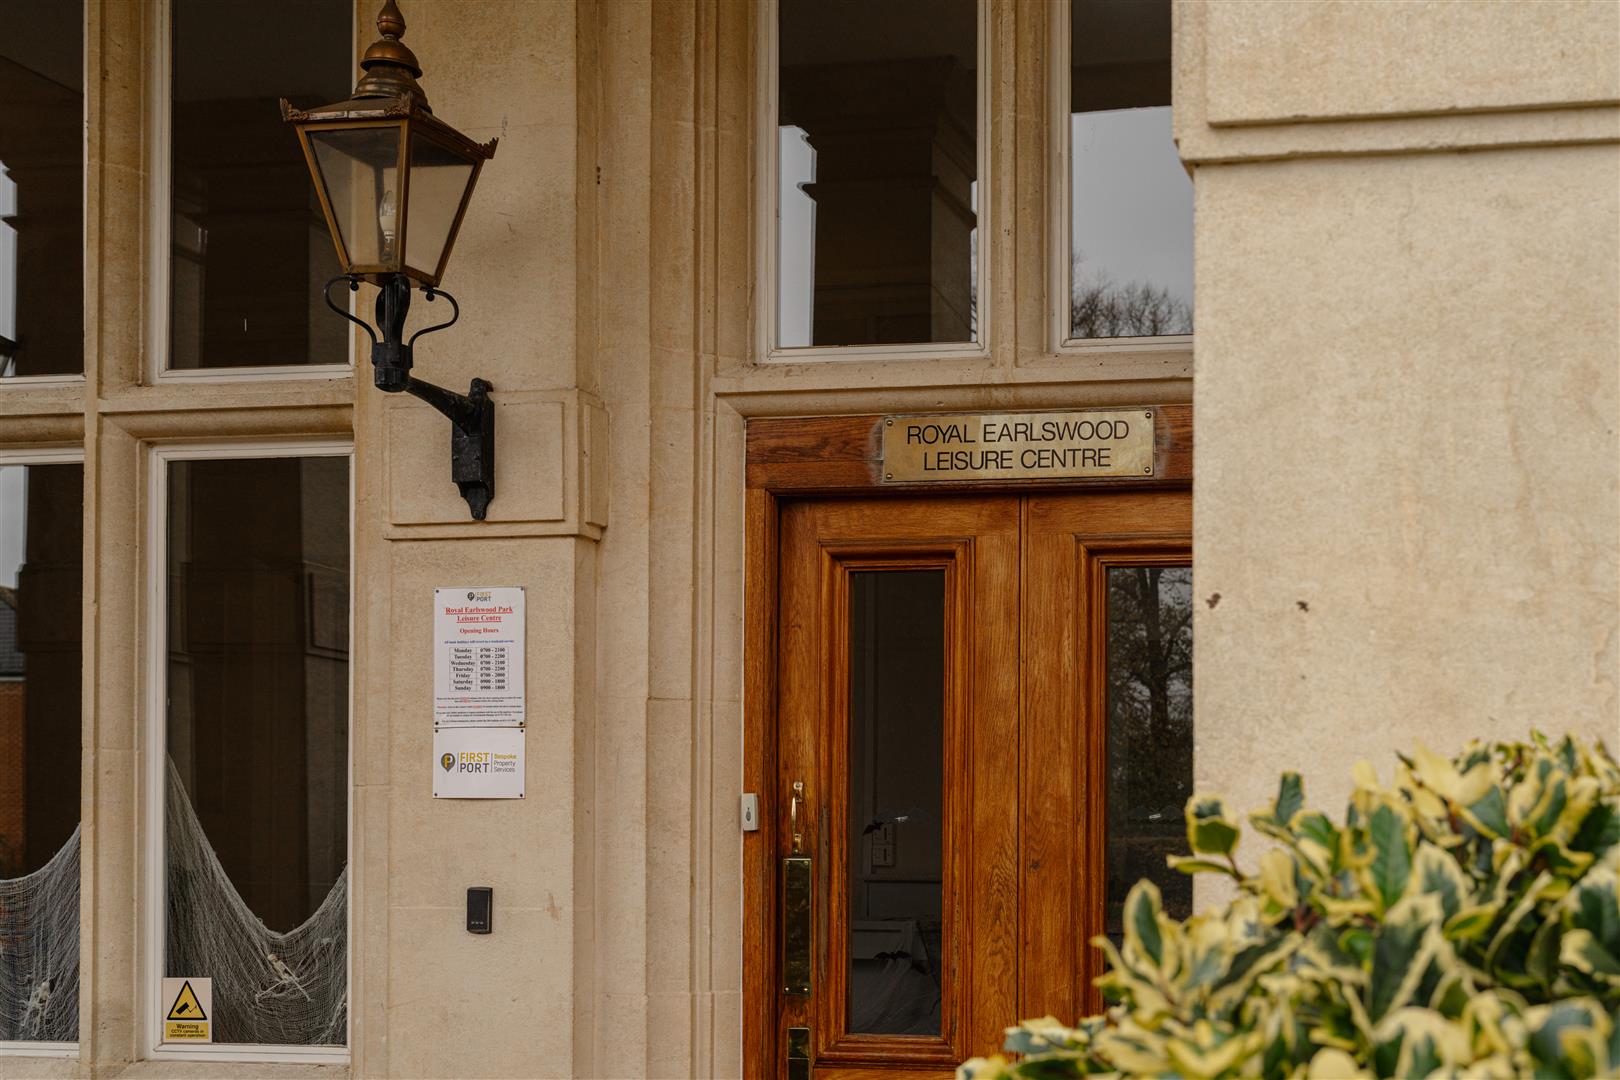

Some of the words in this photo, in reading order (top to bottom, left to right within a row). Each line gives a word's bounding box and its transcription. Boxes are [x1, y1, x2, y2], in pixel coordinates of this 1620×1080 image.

[907, 424, 976, 445] ROYAL
[983, 420, 1130, 443] EARLSWOOD
[923, 450, 1013, 471] LEISURE
[1020, 448, 1112, 470] CENTRE
[465, 606, 497, 614] Earlswood
[460, 752, 489, 763] FIRST
[460, 762, 490, 773] PORT
